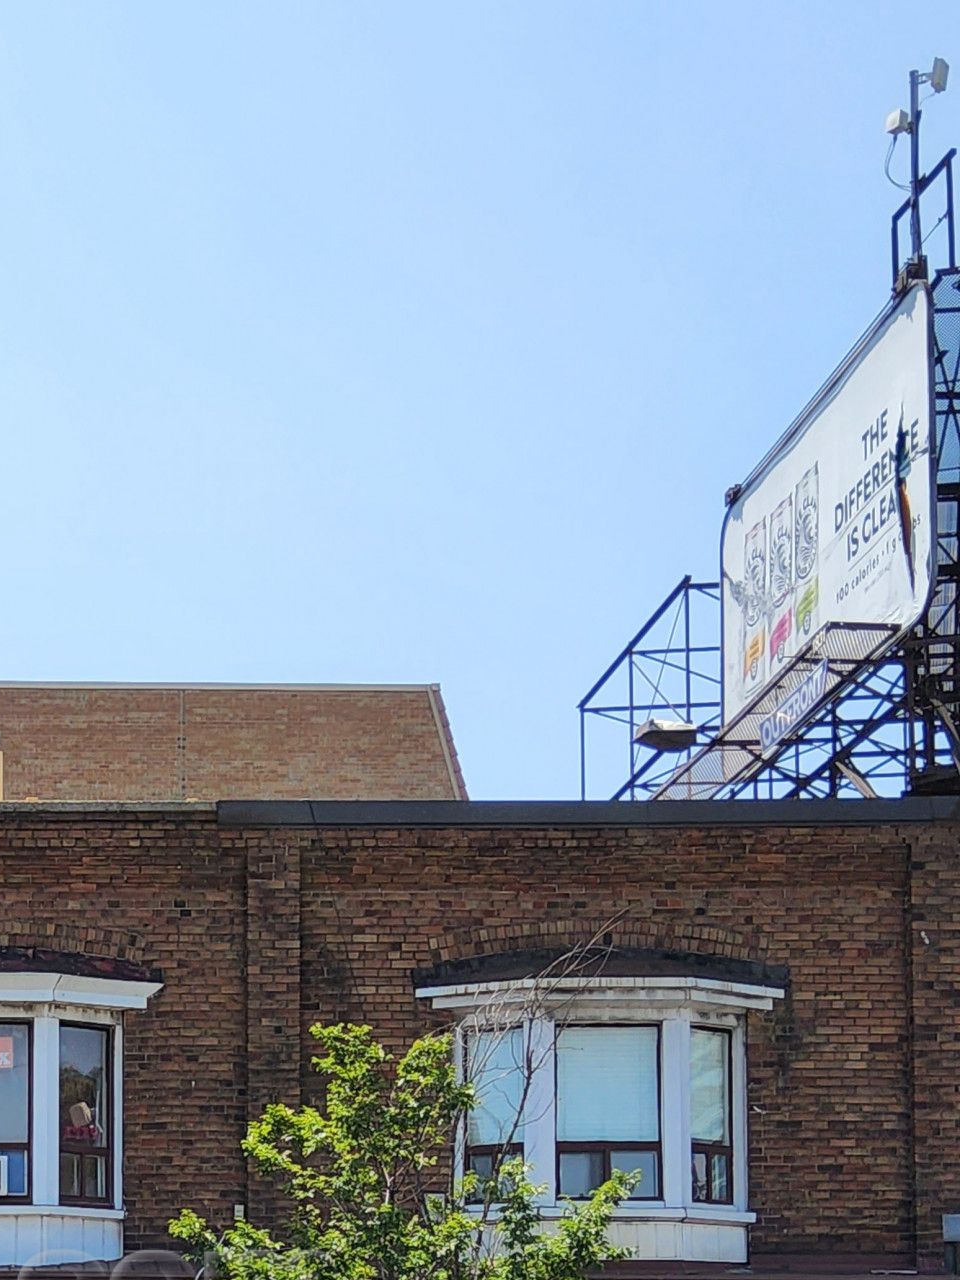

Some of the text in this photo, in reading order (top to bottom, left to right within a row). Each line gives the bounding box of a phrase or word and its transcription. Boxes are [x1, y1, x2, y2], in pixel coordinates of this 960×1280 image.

[861, 408, 889, 461] THE
[847, 525, 860, 563] IS
[862, 487, 898, 545] CLEA
[851, 554, 880, 591] calories
